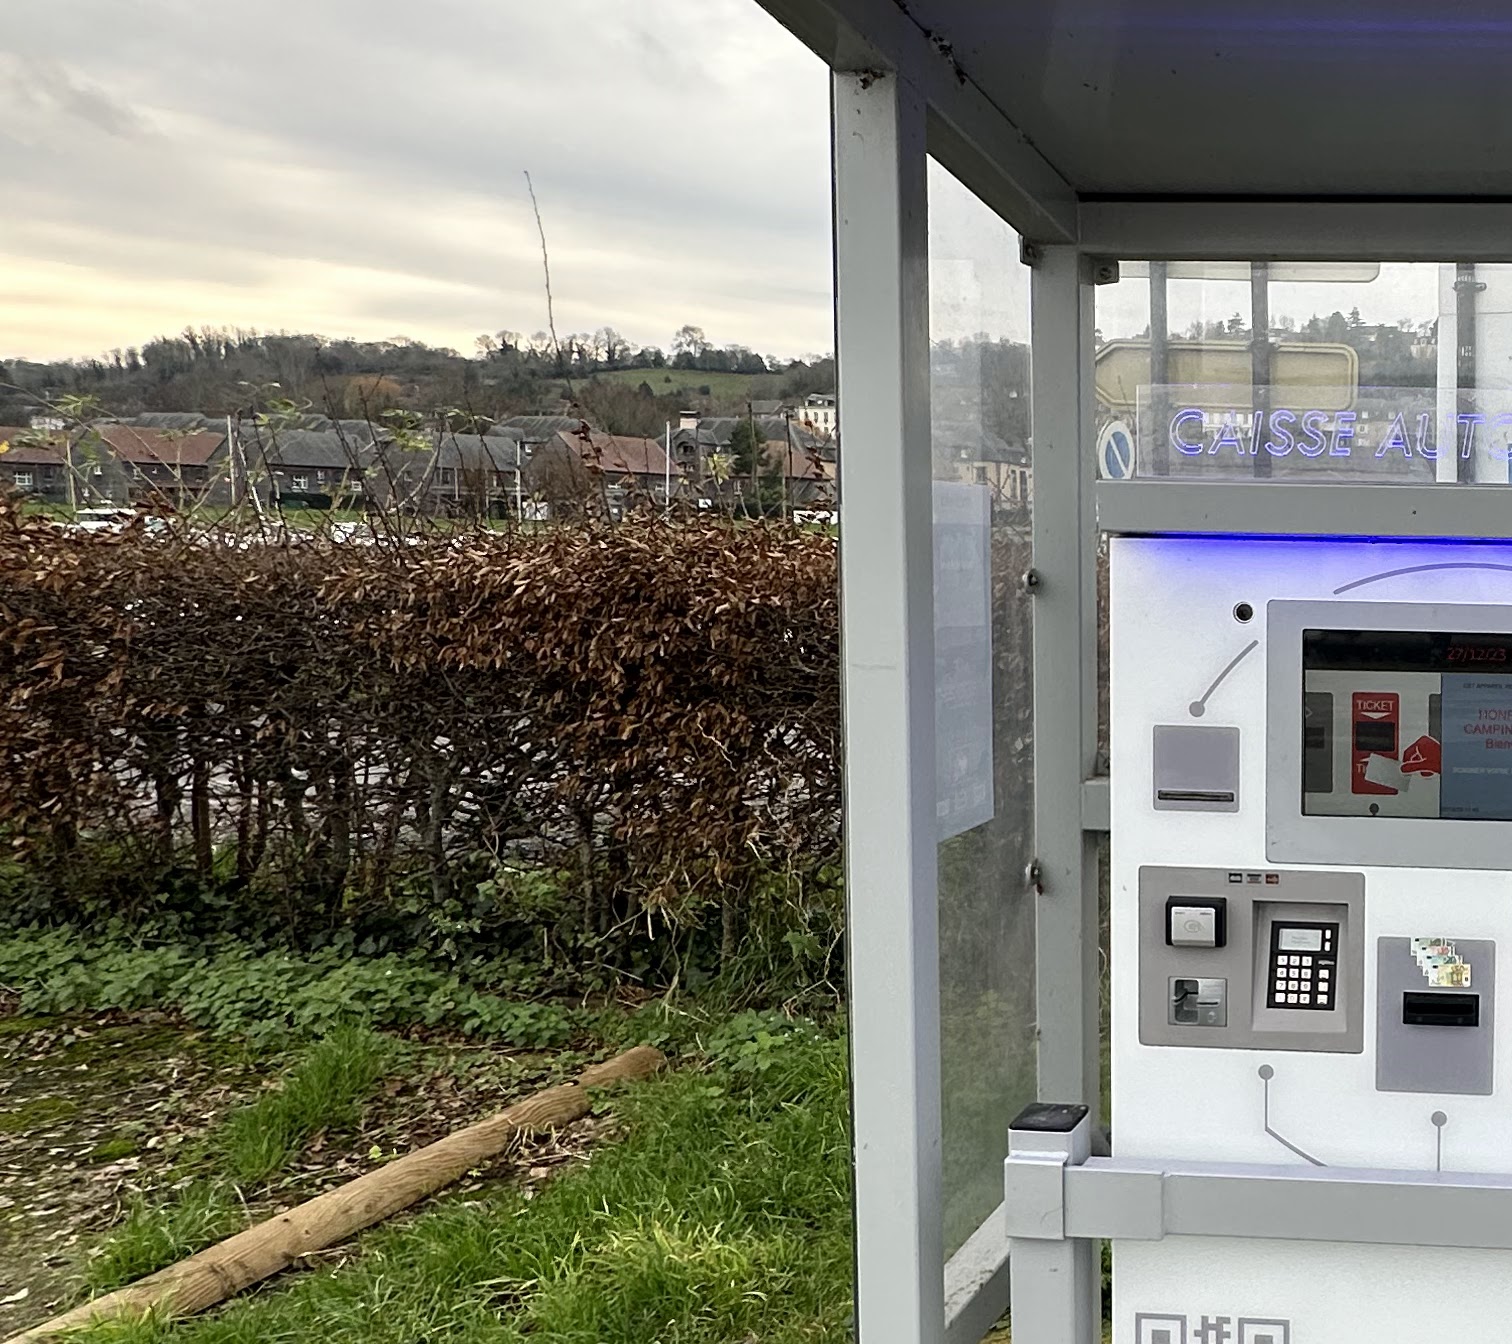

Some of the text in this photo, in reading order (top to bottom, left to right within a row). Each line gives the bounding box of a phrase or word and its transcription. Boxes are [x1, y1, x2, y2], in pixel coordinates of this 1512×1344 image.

[1170, 408, 1357, 457] CAISSE
[1447, 647, 1507, 662] 27/12/23
[1357, 700, 1394, 711] TICKET
